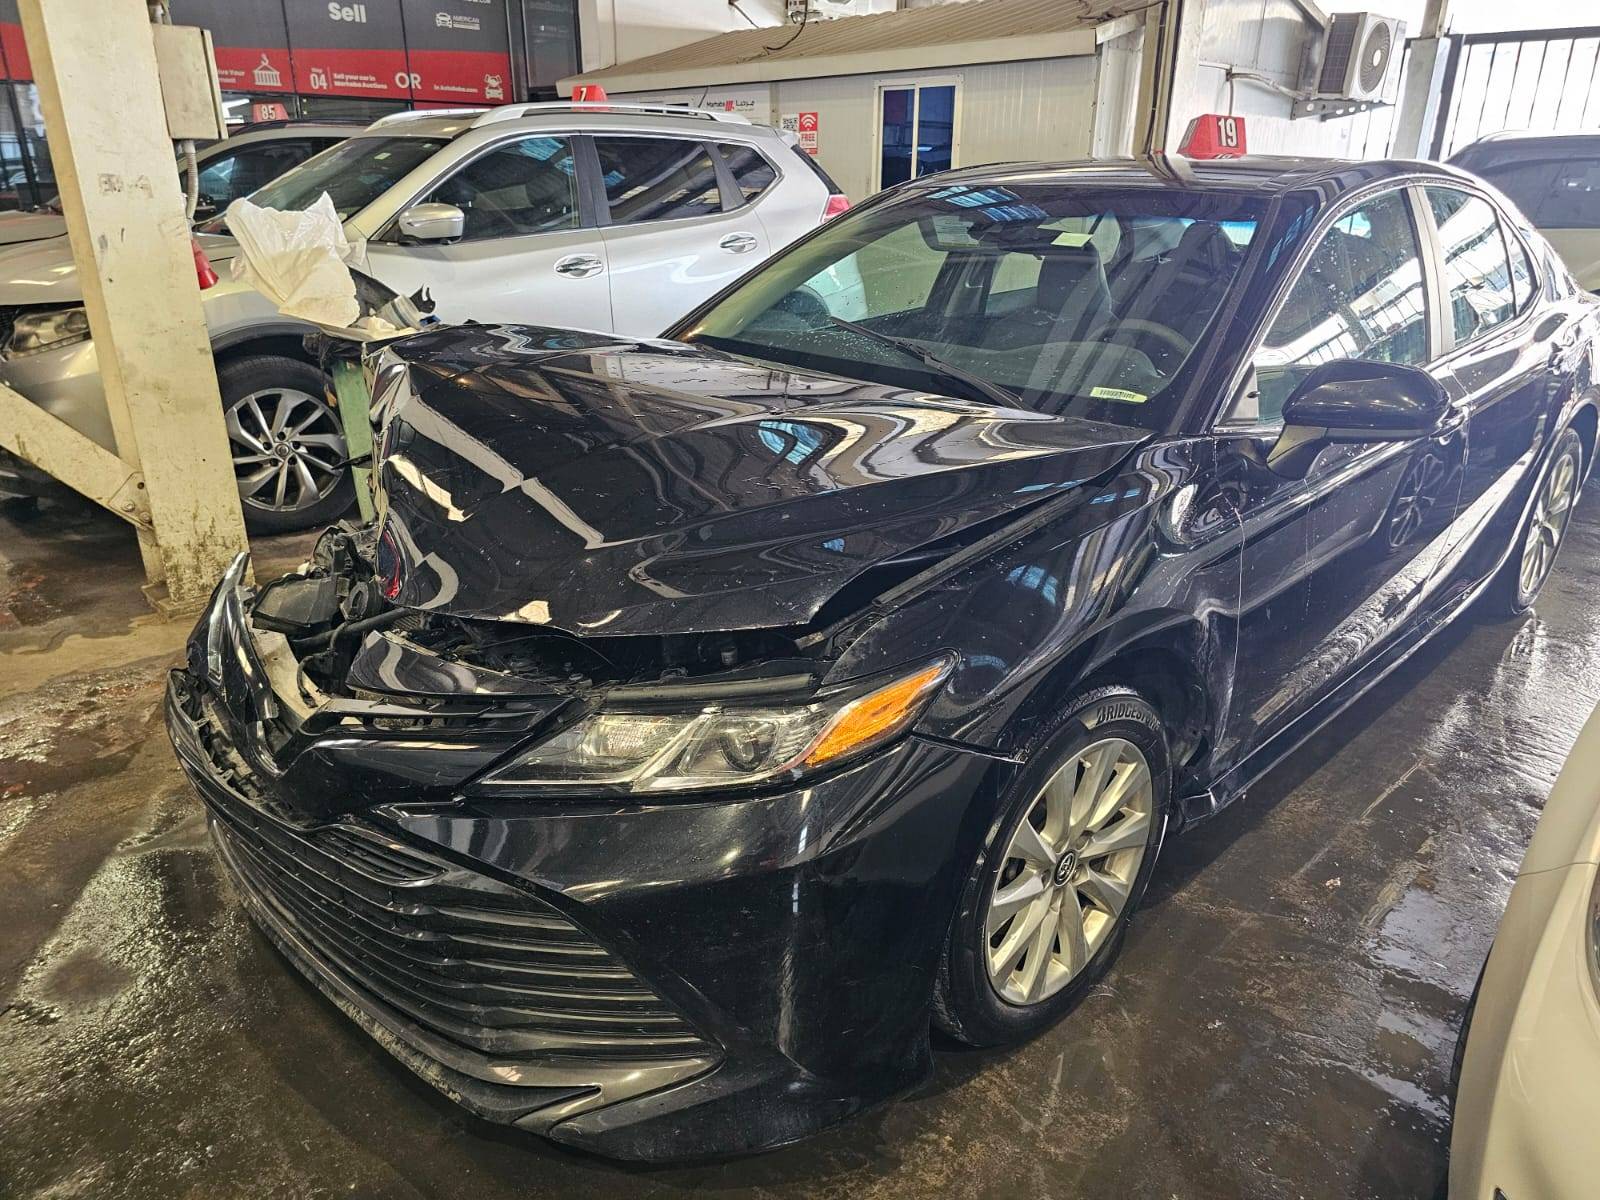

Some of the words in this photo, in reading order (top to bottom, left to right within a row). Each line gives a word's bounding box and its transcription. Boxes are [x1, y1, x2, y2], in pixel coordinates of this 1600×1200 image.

[328, 2, 367, 23] Sell
[453, 15, 480, 23] AMERICAN
[310, 73, 328, 90] 04
[394, 72, 422, 90] OR
[580, 87, 587, 102] 7
[261, 104, 276, 120] 85
[801, 133, 816, 142] FREE
[1218, 117, 1237, 147] 19
[1096, 703, 1160, 731] BRIDGESTONE
